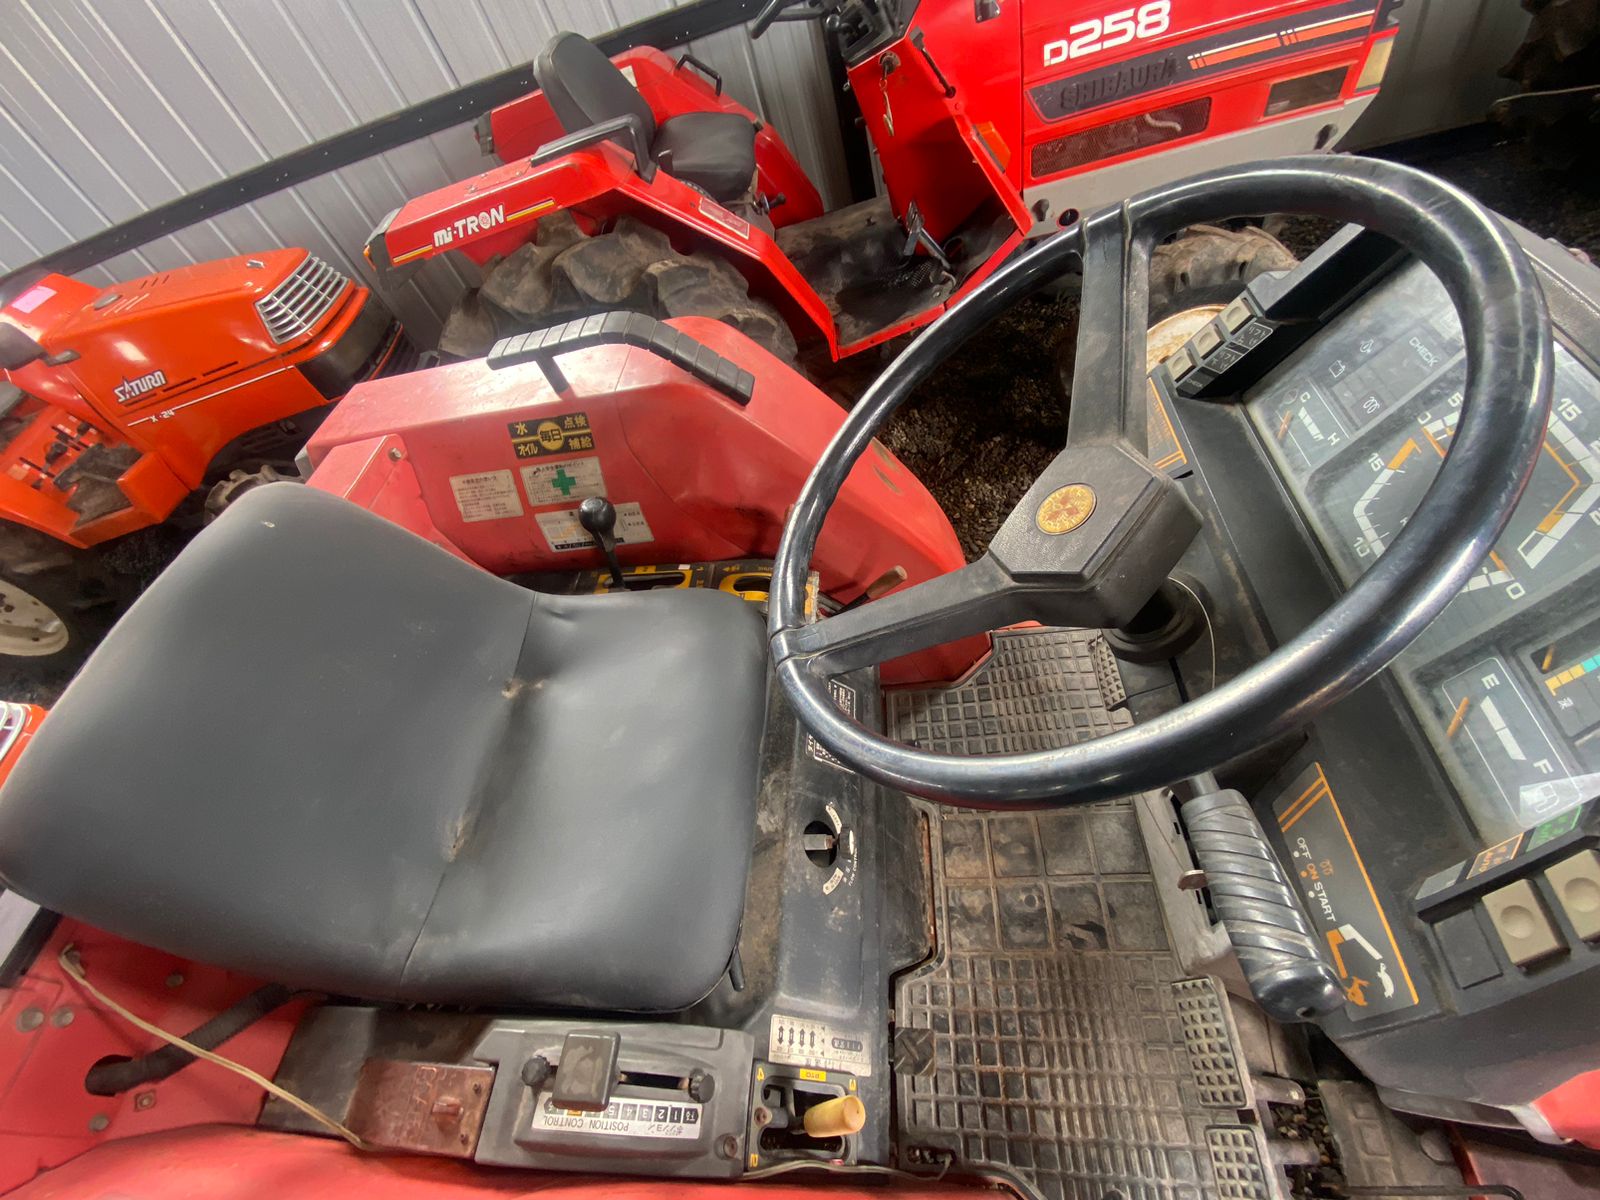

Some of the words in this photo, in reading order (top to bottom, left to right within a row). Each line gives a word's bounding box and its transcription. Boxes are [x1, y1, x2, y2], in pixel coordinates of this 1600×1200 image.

[1043, 0, 1171, 67] D258
[1060, 57, 1177, 108] SHIBAURA
[1409, 336, 1440, 367] CHECK
[113, 369, 167, 402] SATURN
[1300, 391, 1311, 403] C
[1447, 391, 1464, 408] 5
[1556, 397, 1583, 423] 15
[515, 421, 528, 436] 水
[564, 414, 588, 429] 点検
[539, 428, 563, 442] 毎日
[568, 435, 593, 450] 補給
[1327, 431, 1341, 446] H
[517, 442, 539, 456] オイル
[1367, 451, 1385, 472] 15
[1505, 581, 1526, 601] 0
[1480, 672, 1500, 690] E
[1533, 758, 1554, 775] F
[1296, 836, 1312, 860] OFF
[1306, 862, 1320, 880] ON
[1313, 881, 1337, 922] START
[642, 1107, 650, 1119] 3
[658, 1109, 665, 1119] 2
[543, 1115, 585, 1129] CONTROL
[588, 1119, 630, 1132] POSITION
